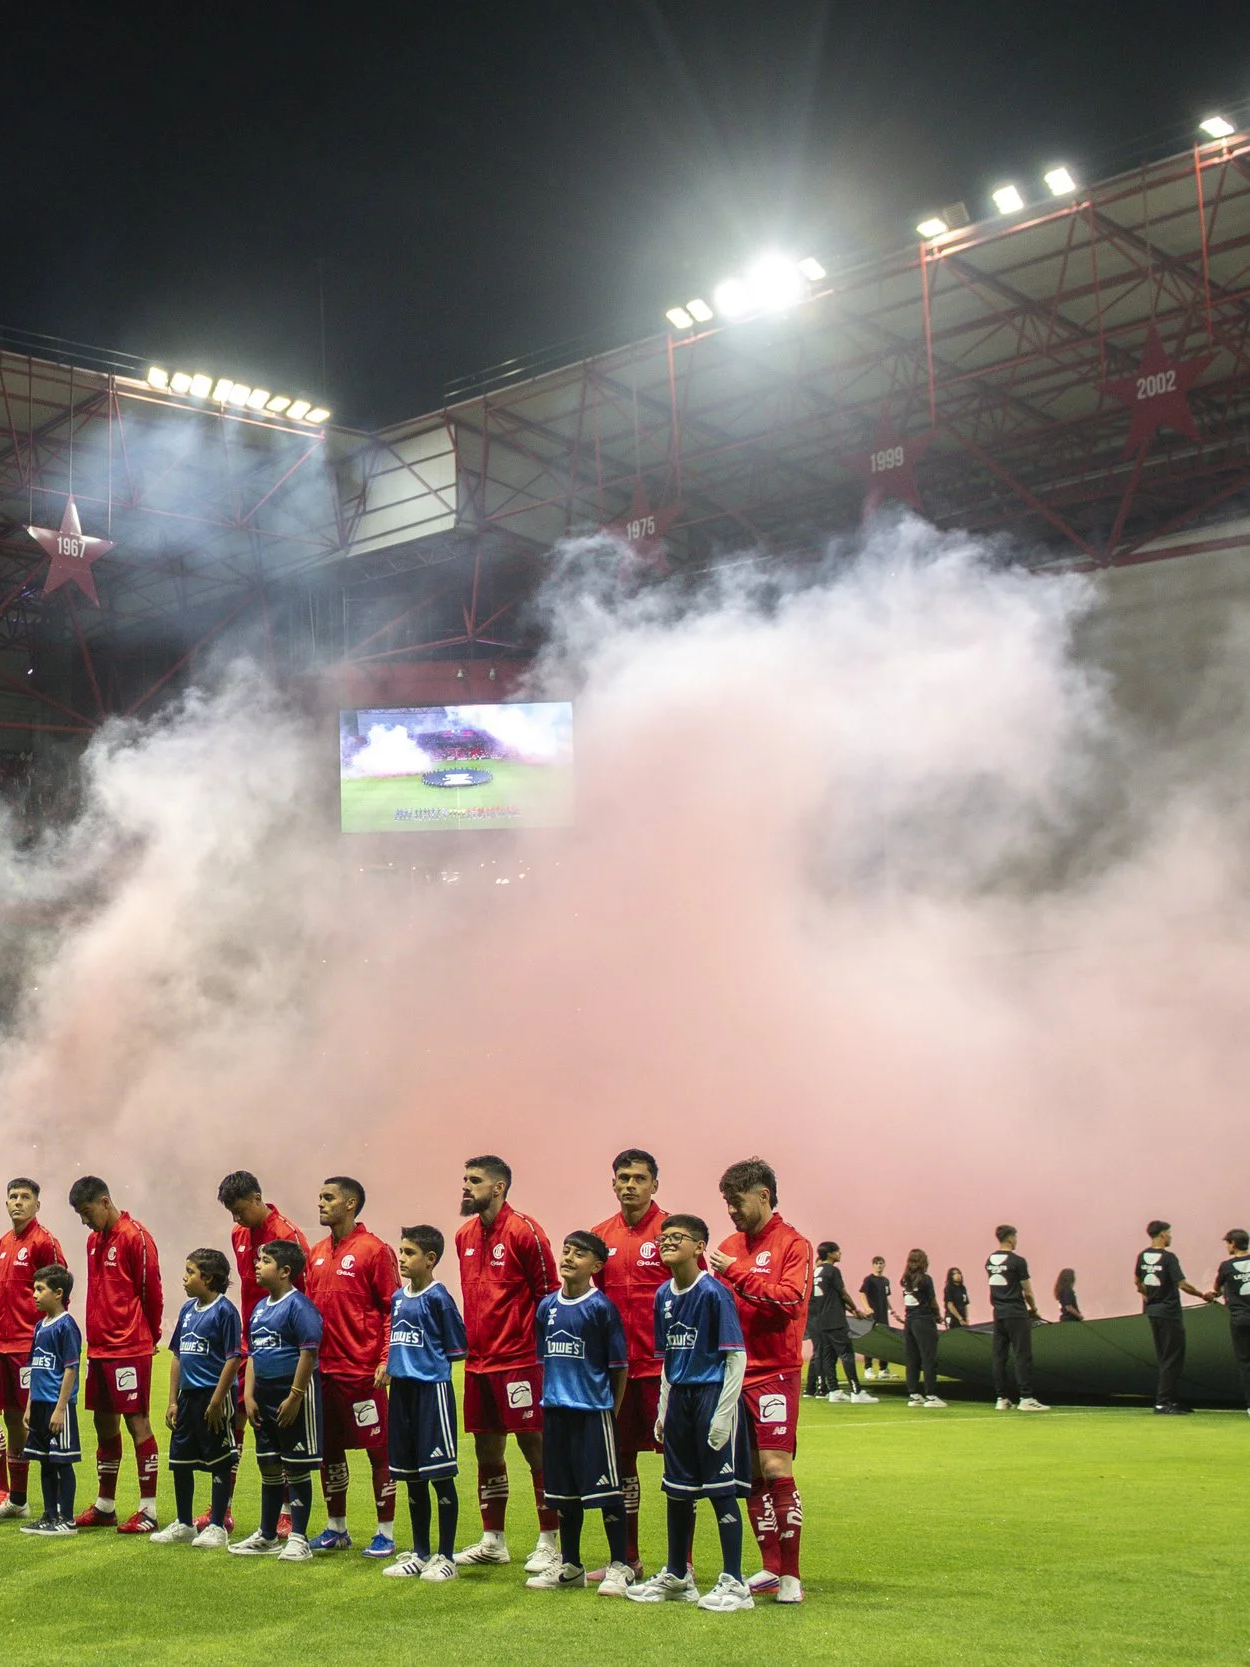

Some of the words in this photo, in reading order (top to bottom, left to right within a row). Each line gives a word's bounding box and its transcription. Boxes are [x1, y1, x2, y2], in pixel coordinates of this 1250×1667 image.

[1136, 370, 1177, 400] 2002
[871, 446, 903, 473] 1999
[626, 516, 655, 541] 1975
[57, 537, 86, 558] 1967
[772, 1426, 787, 1436] NB
